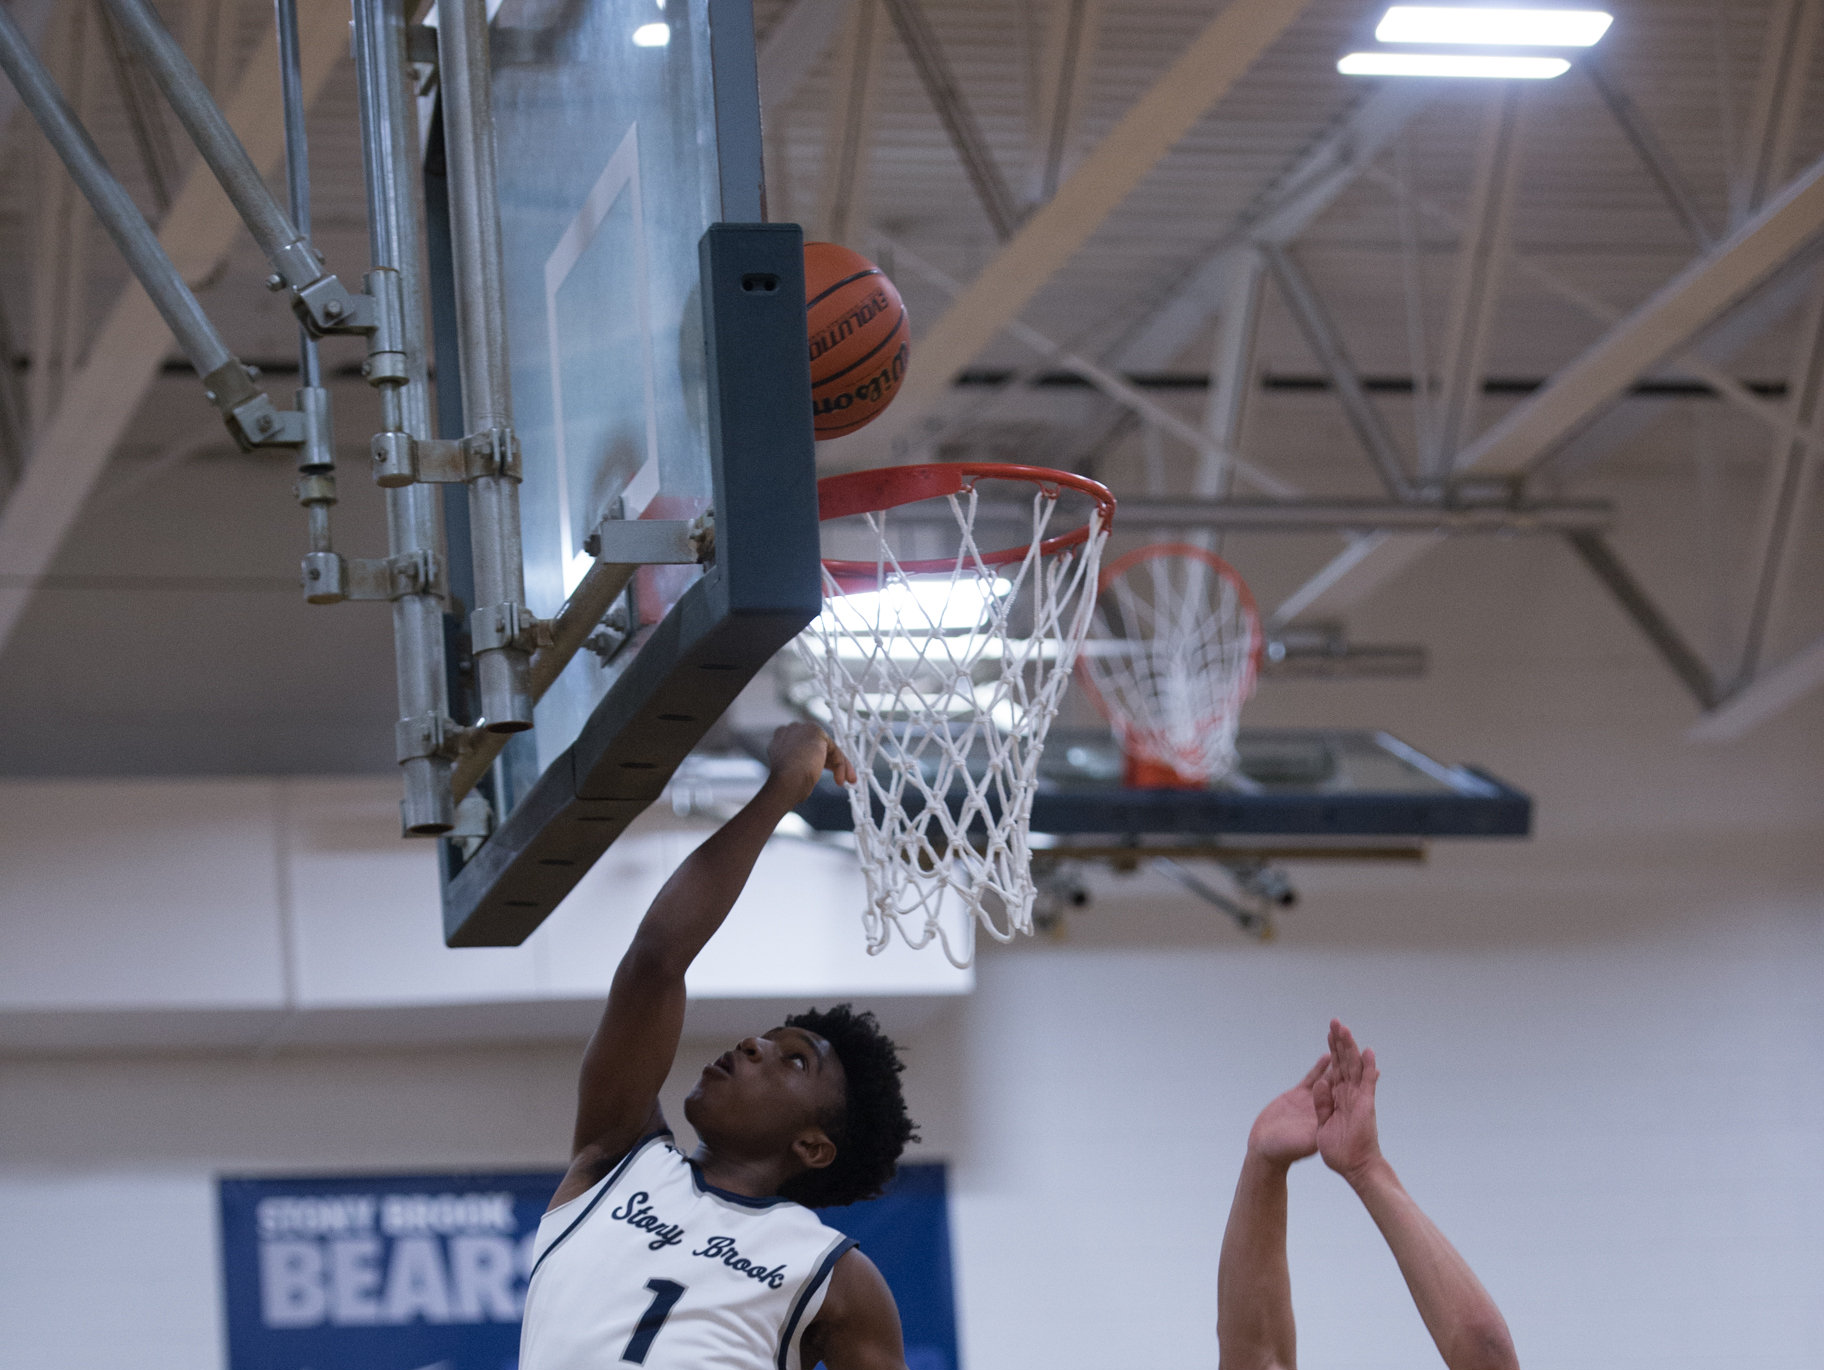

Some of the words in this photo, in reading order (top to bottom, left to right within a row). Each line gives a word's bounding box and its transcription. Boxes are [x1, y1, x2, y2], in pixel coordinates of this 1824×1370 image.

[611, 1191, 685, 1251] Stony
[692, 1236, 787, 1290] Brook
[619, 1277, 688, 1367] 1
